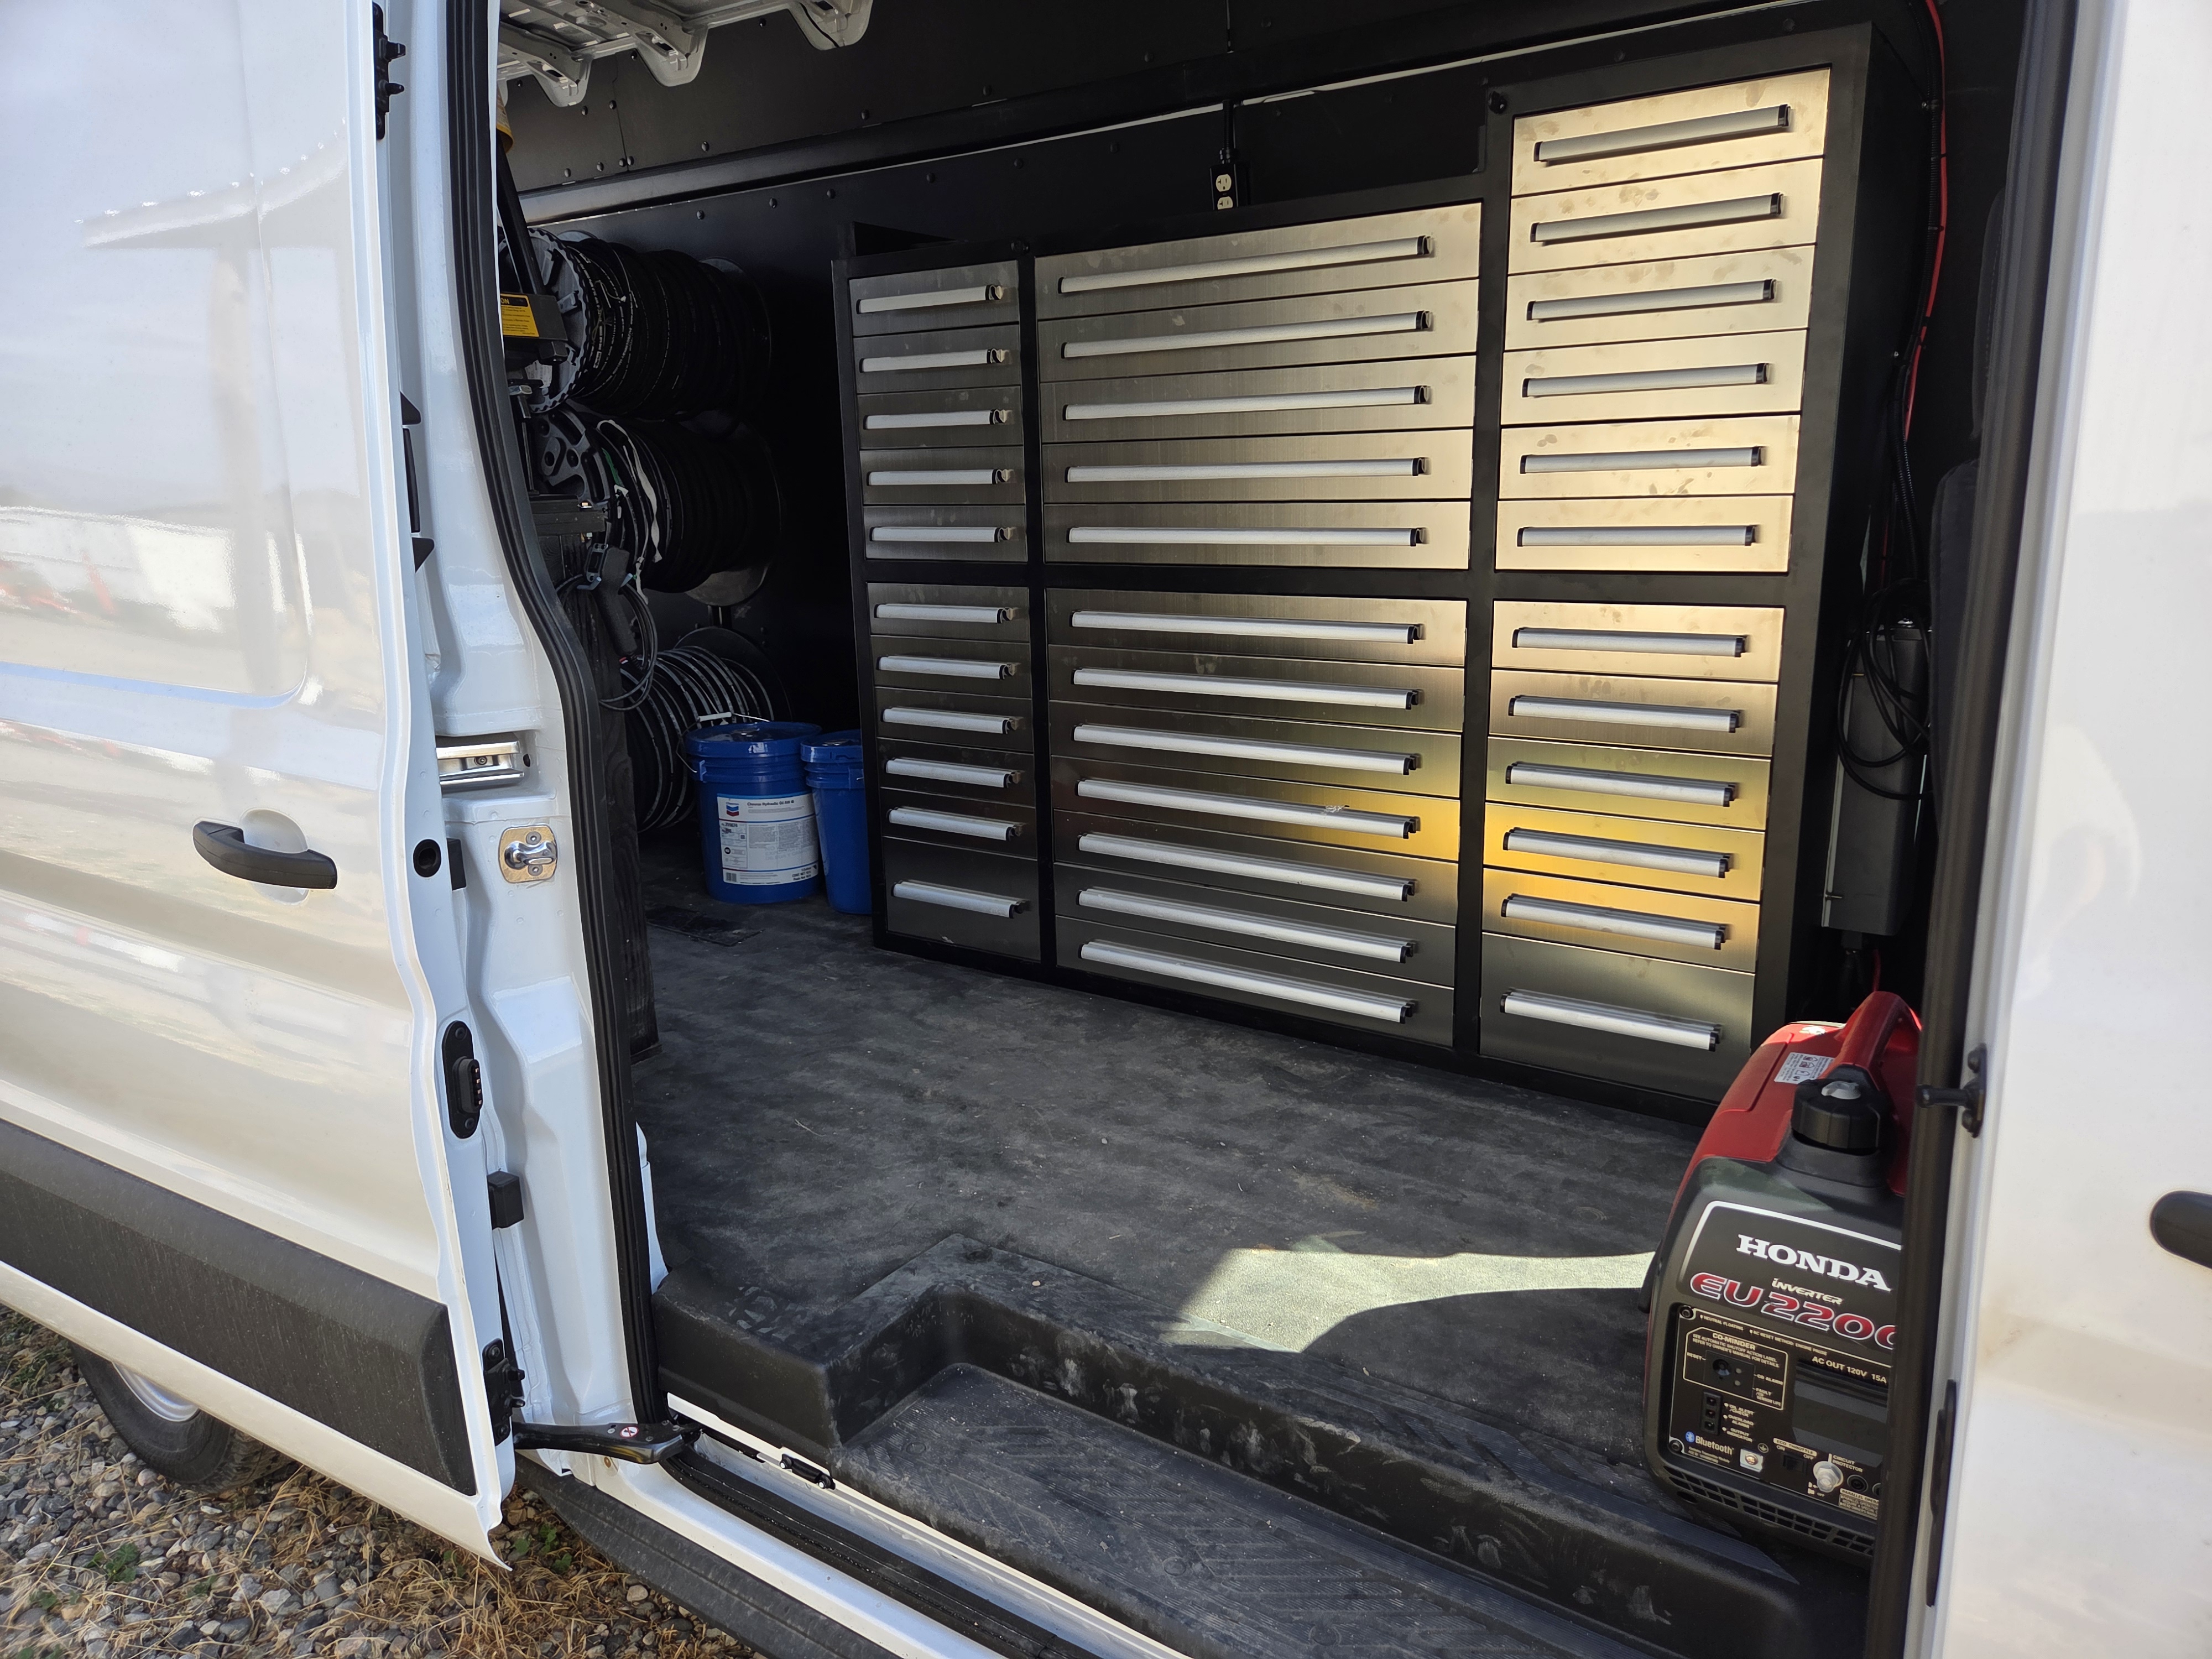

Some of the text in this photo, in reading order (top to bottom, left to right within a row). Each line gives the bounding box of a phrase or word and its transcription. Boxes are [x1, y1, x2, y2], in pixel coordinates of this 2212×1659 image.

[1736, 1234, 1893, 1292] HONDA
[1703, 1316, 1744, 1331] NEUTRAL FLOATING
[1712, 1332, 1756, 1350] CO-MINDER
[1692, 1337, 1705, 1345] REFER
[1732, 1350, 1751, 1360] MANUAL
[1701, 1337, 1726, 1347] AUTOMATIC
[1726, 1344, 1746, 1353] SHUTOFF
[1746, 1350, 1762, 1359] ACTION
[1812, 1355, 1887, 1384] AC OUT 120V 15A
[1756, 1387, 1772, 1397] FAULT
[1738, 1407, 1755, 1415] ALERT
[1728, 1414, 1754, 1426] OVERLOAD
[1731, 1420, 1750, 1428] ALARM
[1726, 1431, 1753, 1443] INDICATOR
[1730, 1427, 1750, 1437] OUTPUT
[1695, 1435, 1733, 1455] Bluetooth
[1788, 1443, 1813, 1455] THROTTLE
[1833, 1454, 1856, 1465] CIRCUIT
[1832, 1459, 1863, 1473] PROTECTOR
[1841, 1489, 1864, 1500] PARALLEL
